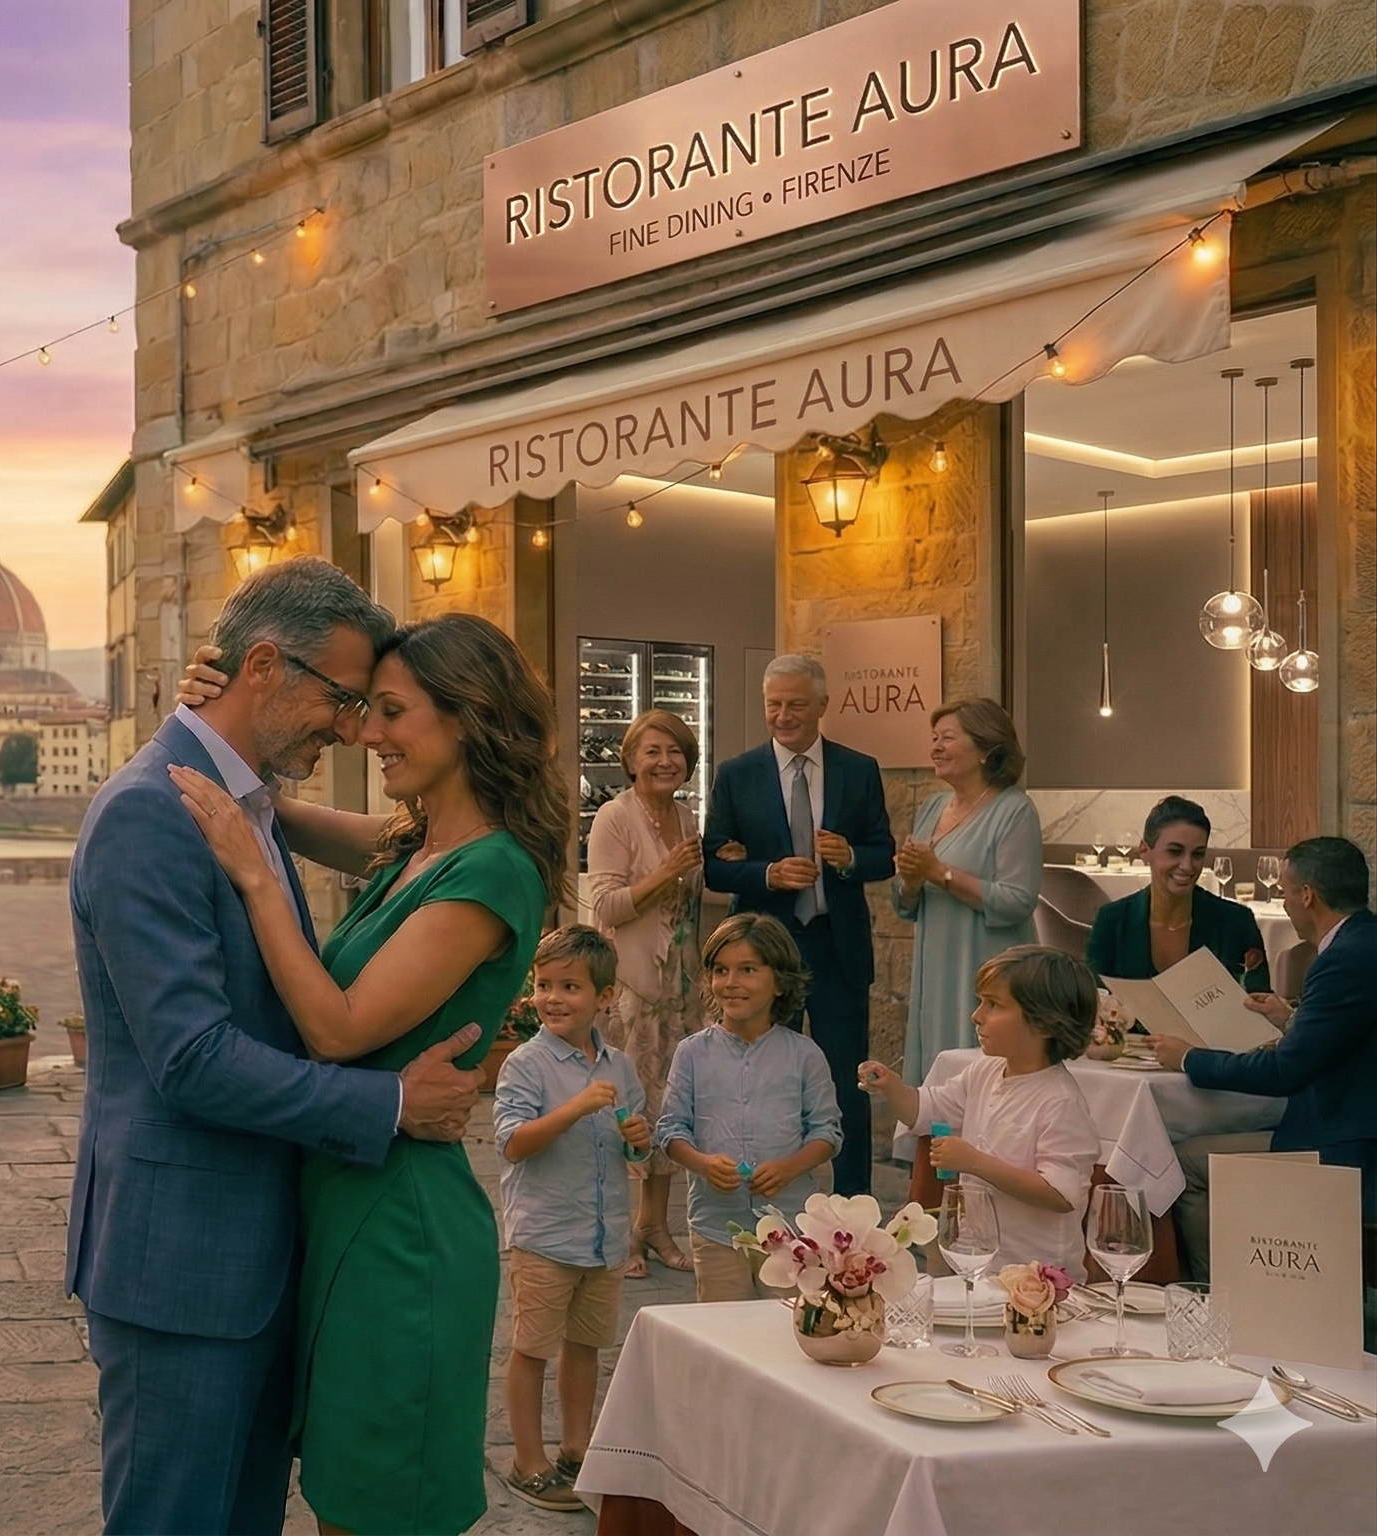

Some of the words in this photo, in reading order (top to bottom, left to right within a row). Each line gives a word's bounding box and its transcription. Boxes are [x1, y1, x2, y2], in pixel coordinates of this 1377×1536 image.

[506, 86, 833, 245] RISTORANTE
[852, 21, 1039, 134] AURA
[608, 220, 660, 256] FINE
[667, 191, 754, 240] DINING
[782, 148, 892, 205] FIRENZE
[488, 378, 778, 487] RISTORANTE
[796, 336, 963, 420] AURA
[839, 683, 926, 714] AURA
[1195, 987, 1225, 1010] AURA
[1250, 1236, 1318, 1250] RISTORANTE
[1250, 1248, 1321, 1273] AURA
